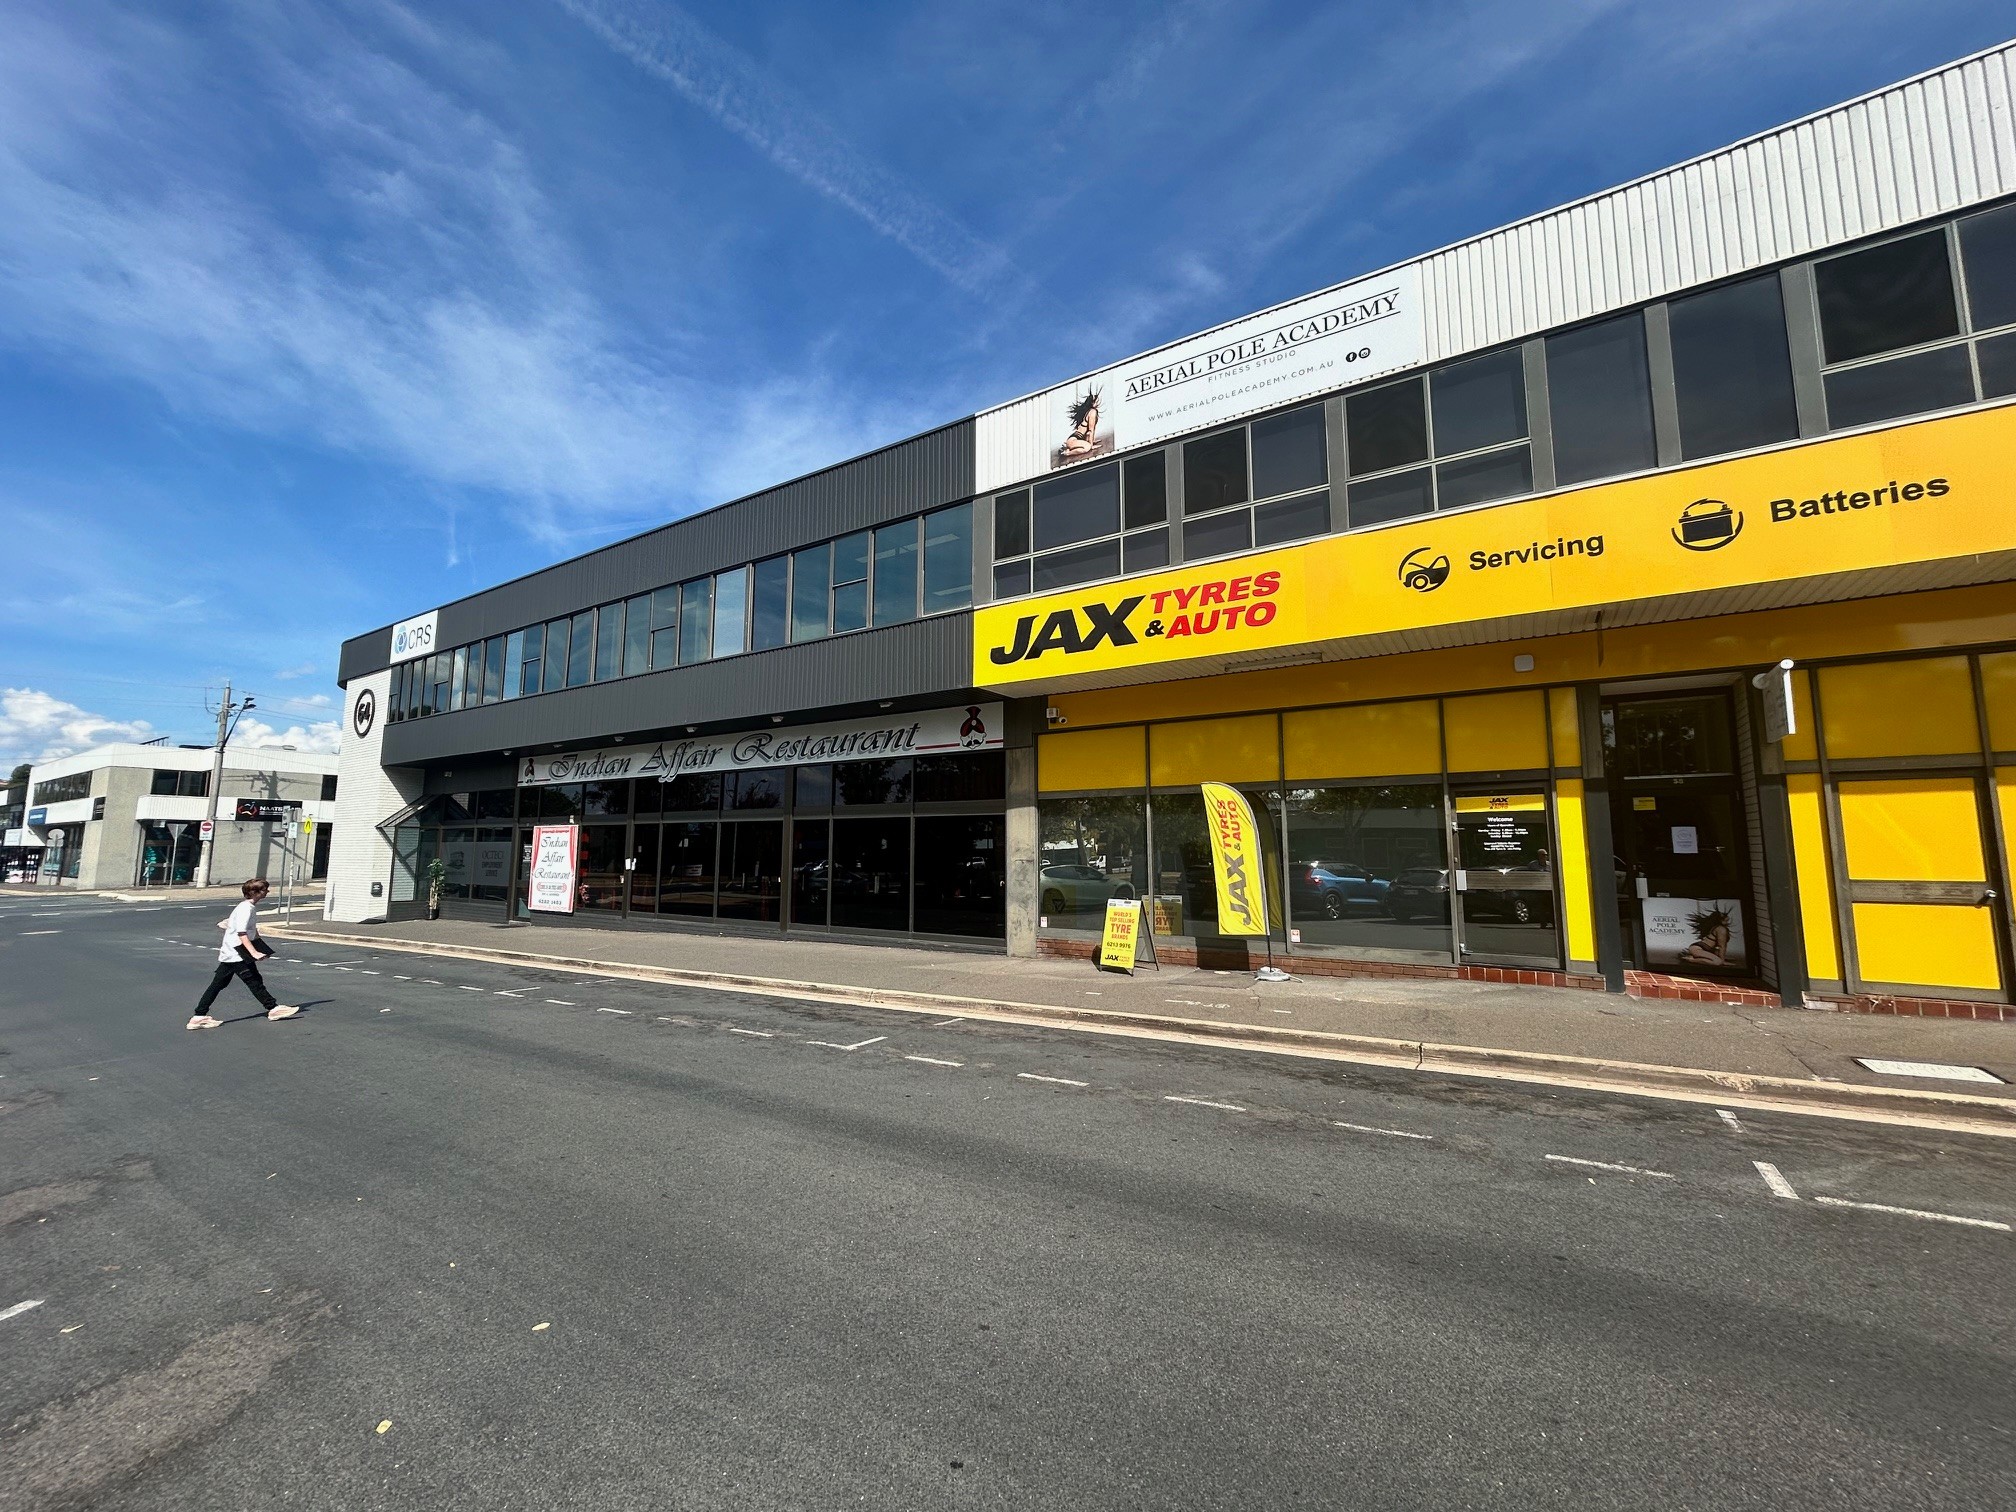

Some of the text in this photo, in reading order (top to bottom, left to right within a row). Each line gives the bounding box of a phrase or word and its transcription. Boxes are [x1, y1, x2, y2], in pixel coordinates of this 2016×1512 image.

[1125, 293, 1399, 397] AERIAL POLE ACADEMY
[1208, 350, 1296, 383] FITNESS STUDIO
[1148, 360, 1334, 422] WWW.AERIALPOLEACADEMY.COM.AU
[1770, 477, 1950, 522] Batteries
[1469, 534, 1604, 571] Servicing
[1150, 571, 1281, 614] TYRES
[408, 624, 432, 649] CRS
[990, 595, 1146, 665] JAX
[1145, 602, 1277, 639] & AUTO
[550, 722, 921, 782] Indian Affair Restaurant
[541, 837, 568, 847] Indian
[1217, 799, 1231, 849] TYRES
[1227, 800, 1242, 842] AUTO
[534, 868, 570, 879] Restaurant
[541, 851, 565, 866] Affair
[1225, 853, 1251, 926] JAX
[1111, 924, 1131, 934] TYRE
